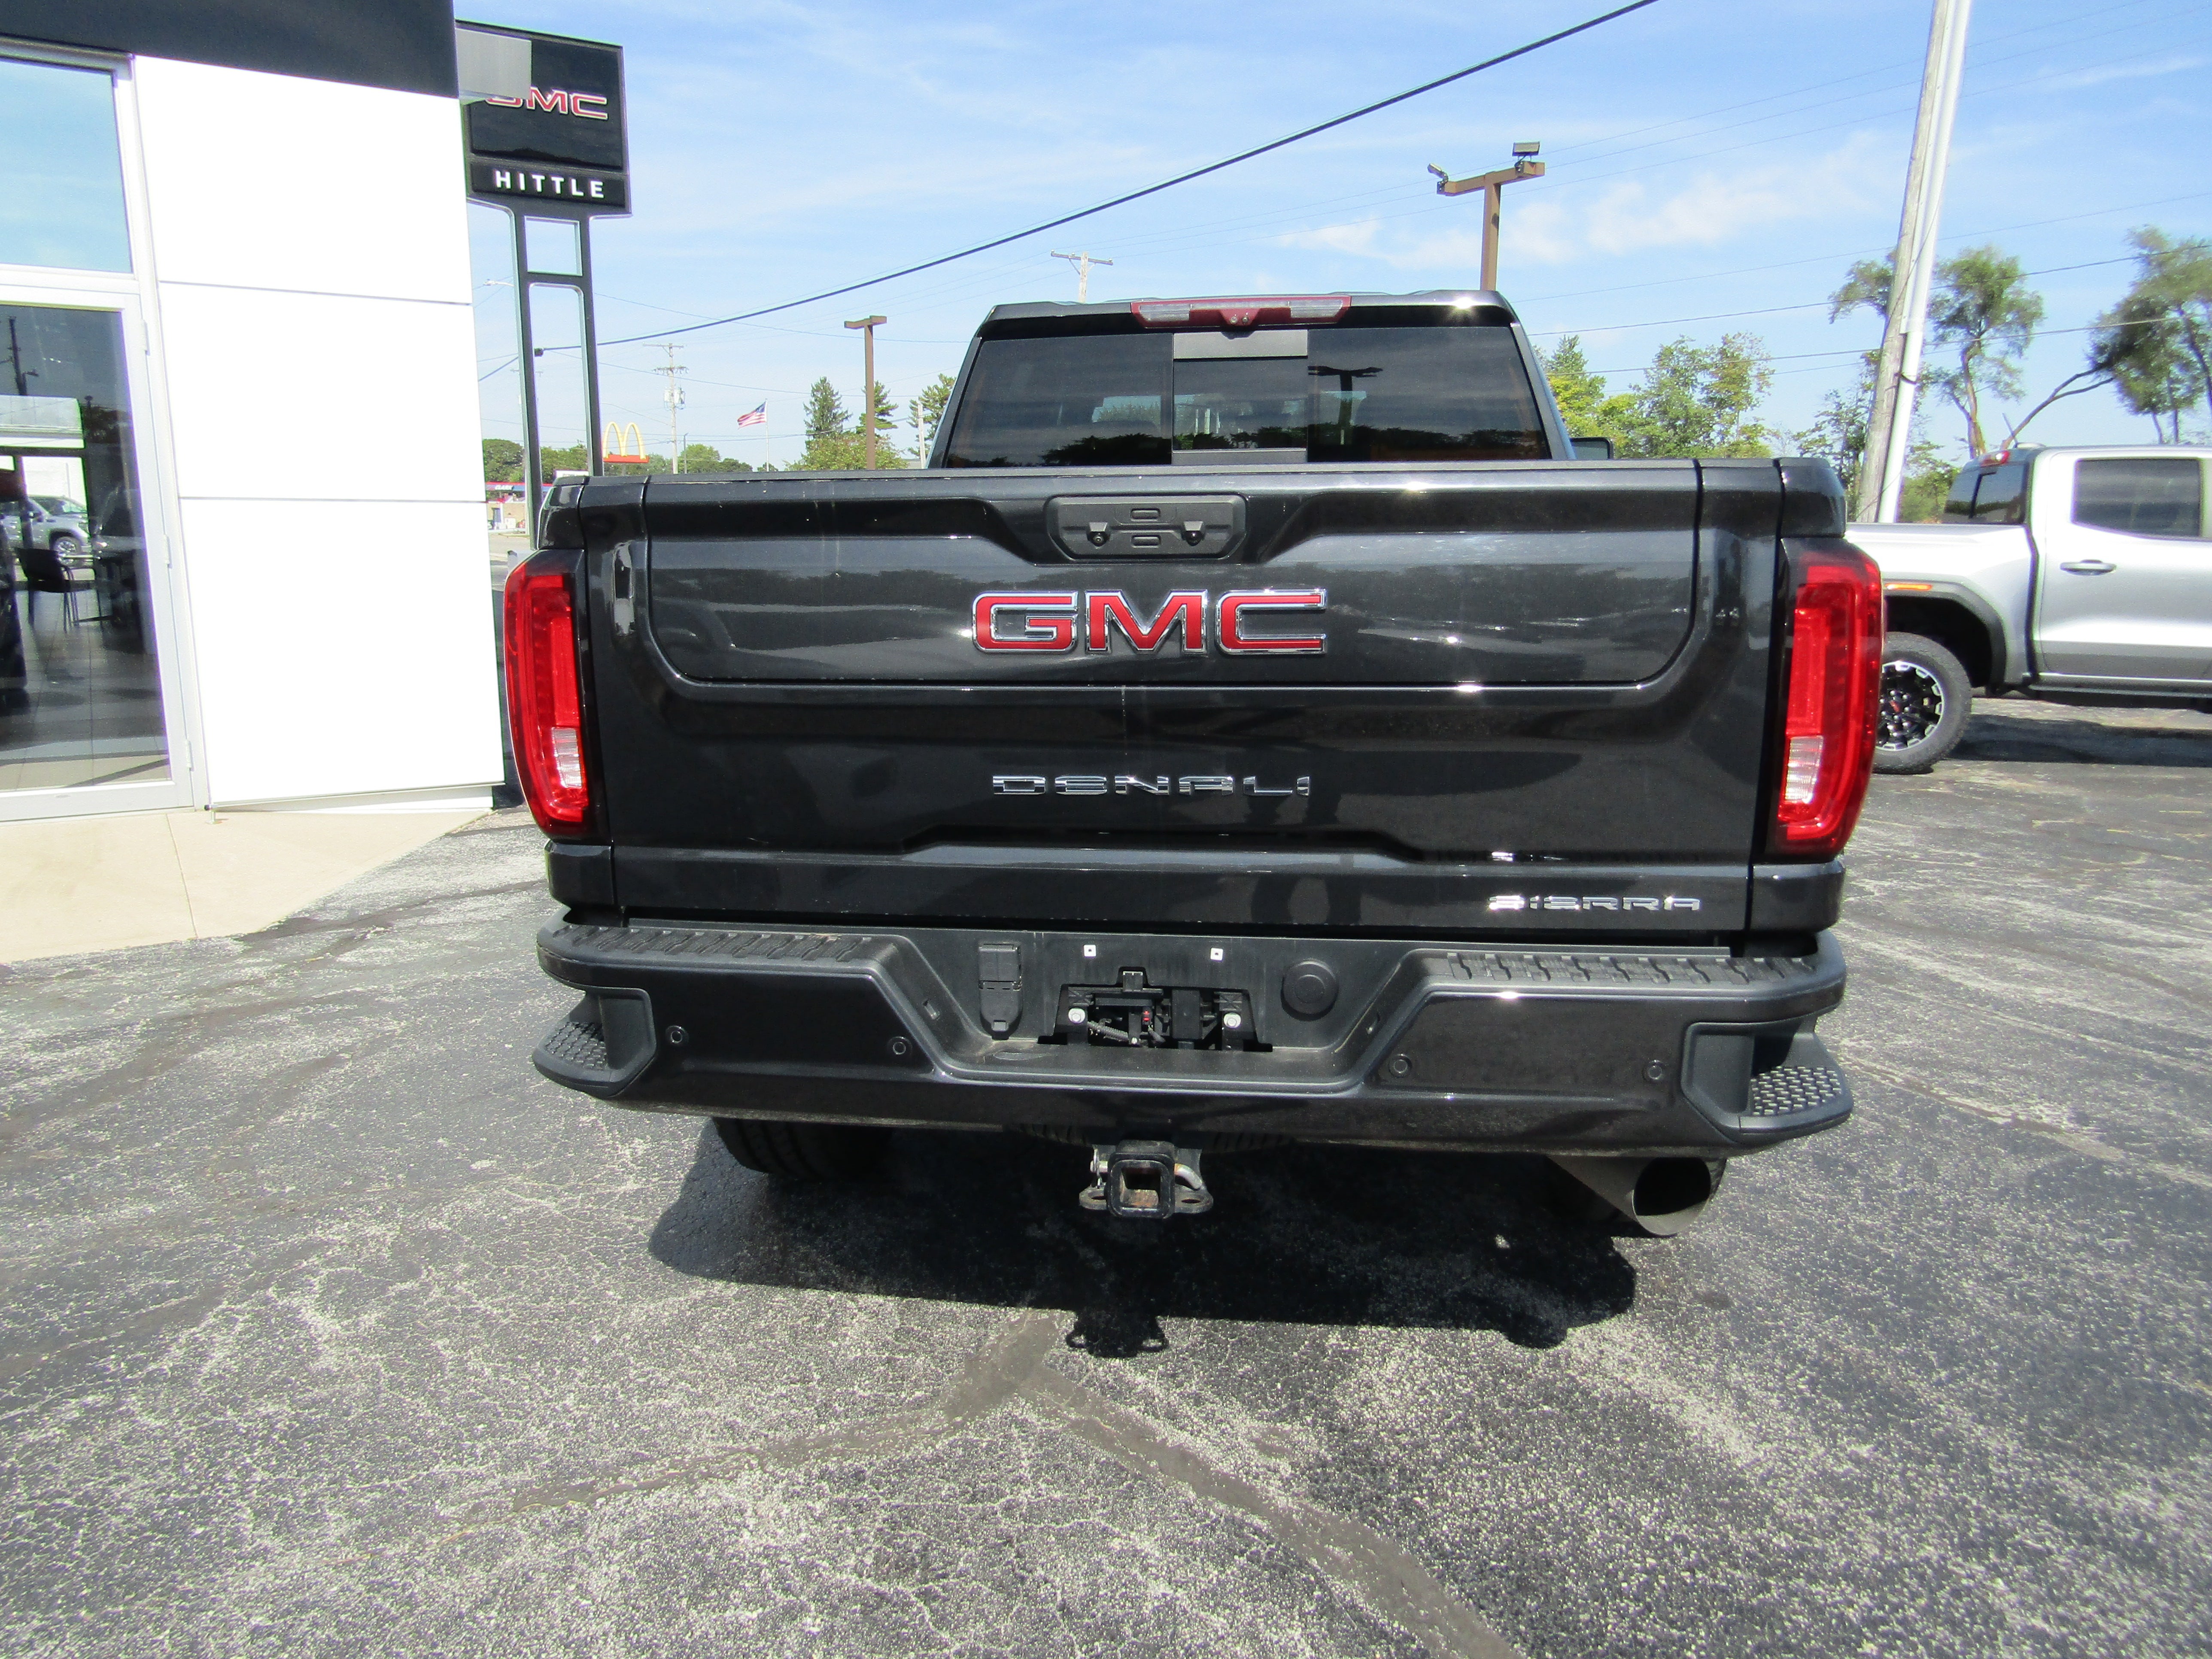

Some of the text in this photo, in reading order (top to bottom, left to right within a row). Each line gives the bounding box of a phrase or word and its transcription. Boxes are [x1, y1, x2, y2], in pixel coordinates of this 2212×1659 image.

[495, 170, 605, 199] HITTLE
[972, 589, 1327, 655] GMC
[992, 775, 1310, 796] DENALI
[1489, 895, 1701, 911] SIERRA
